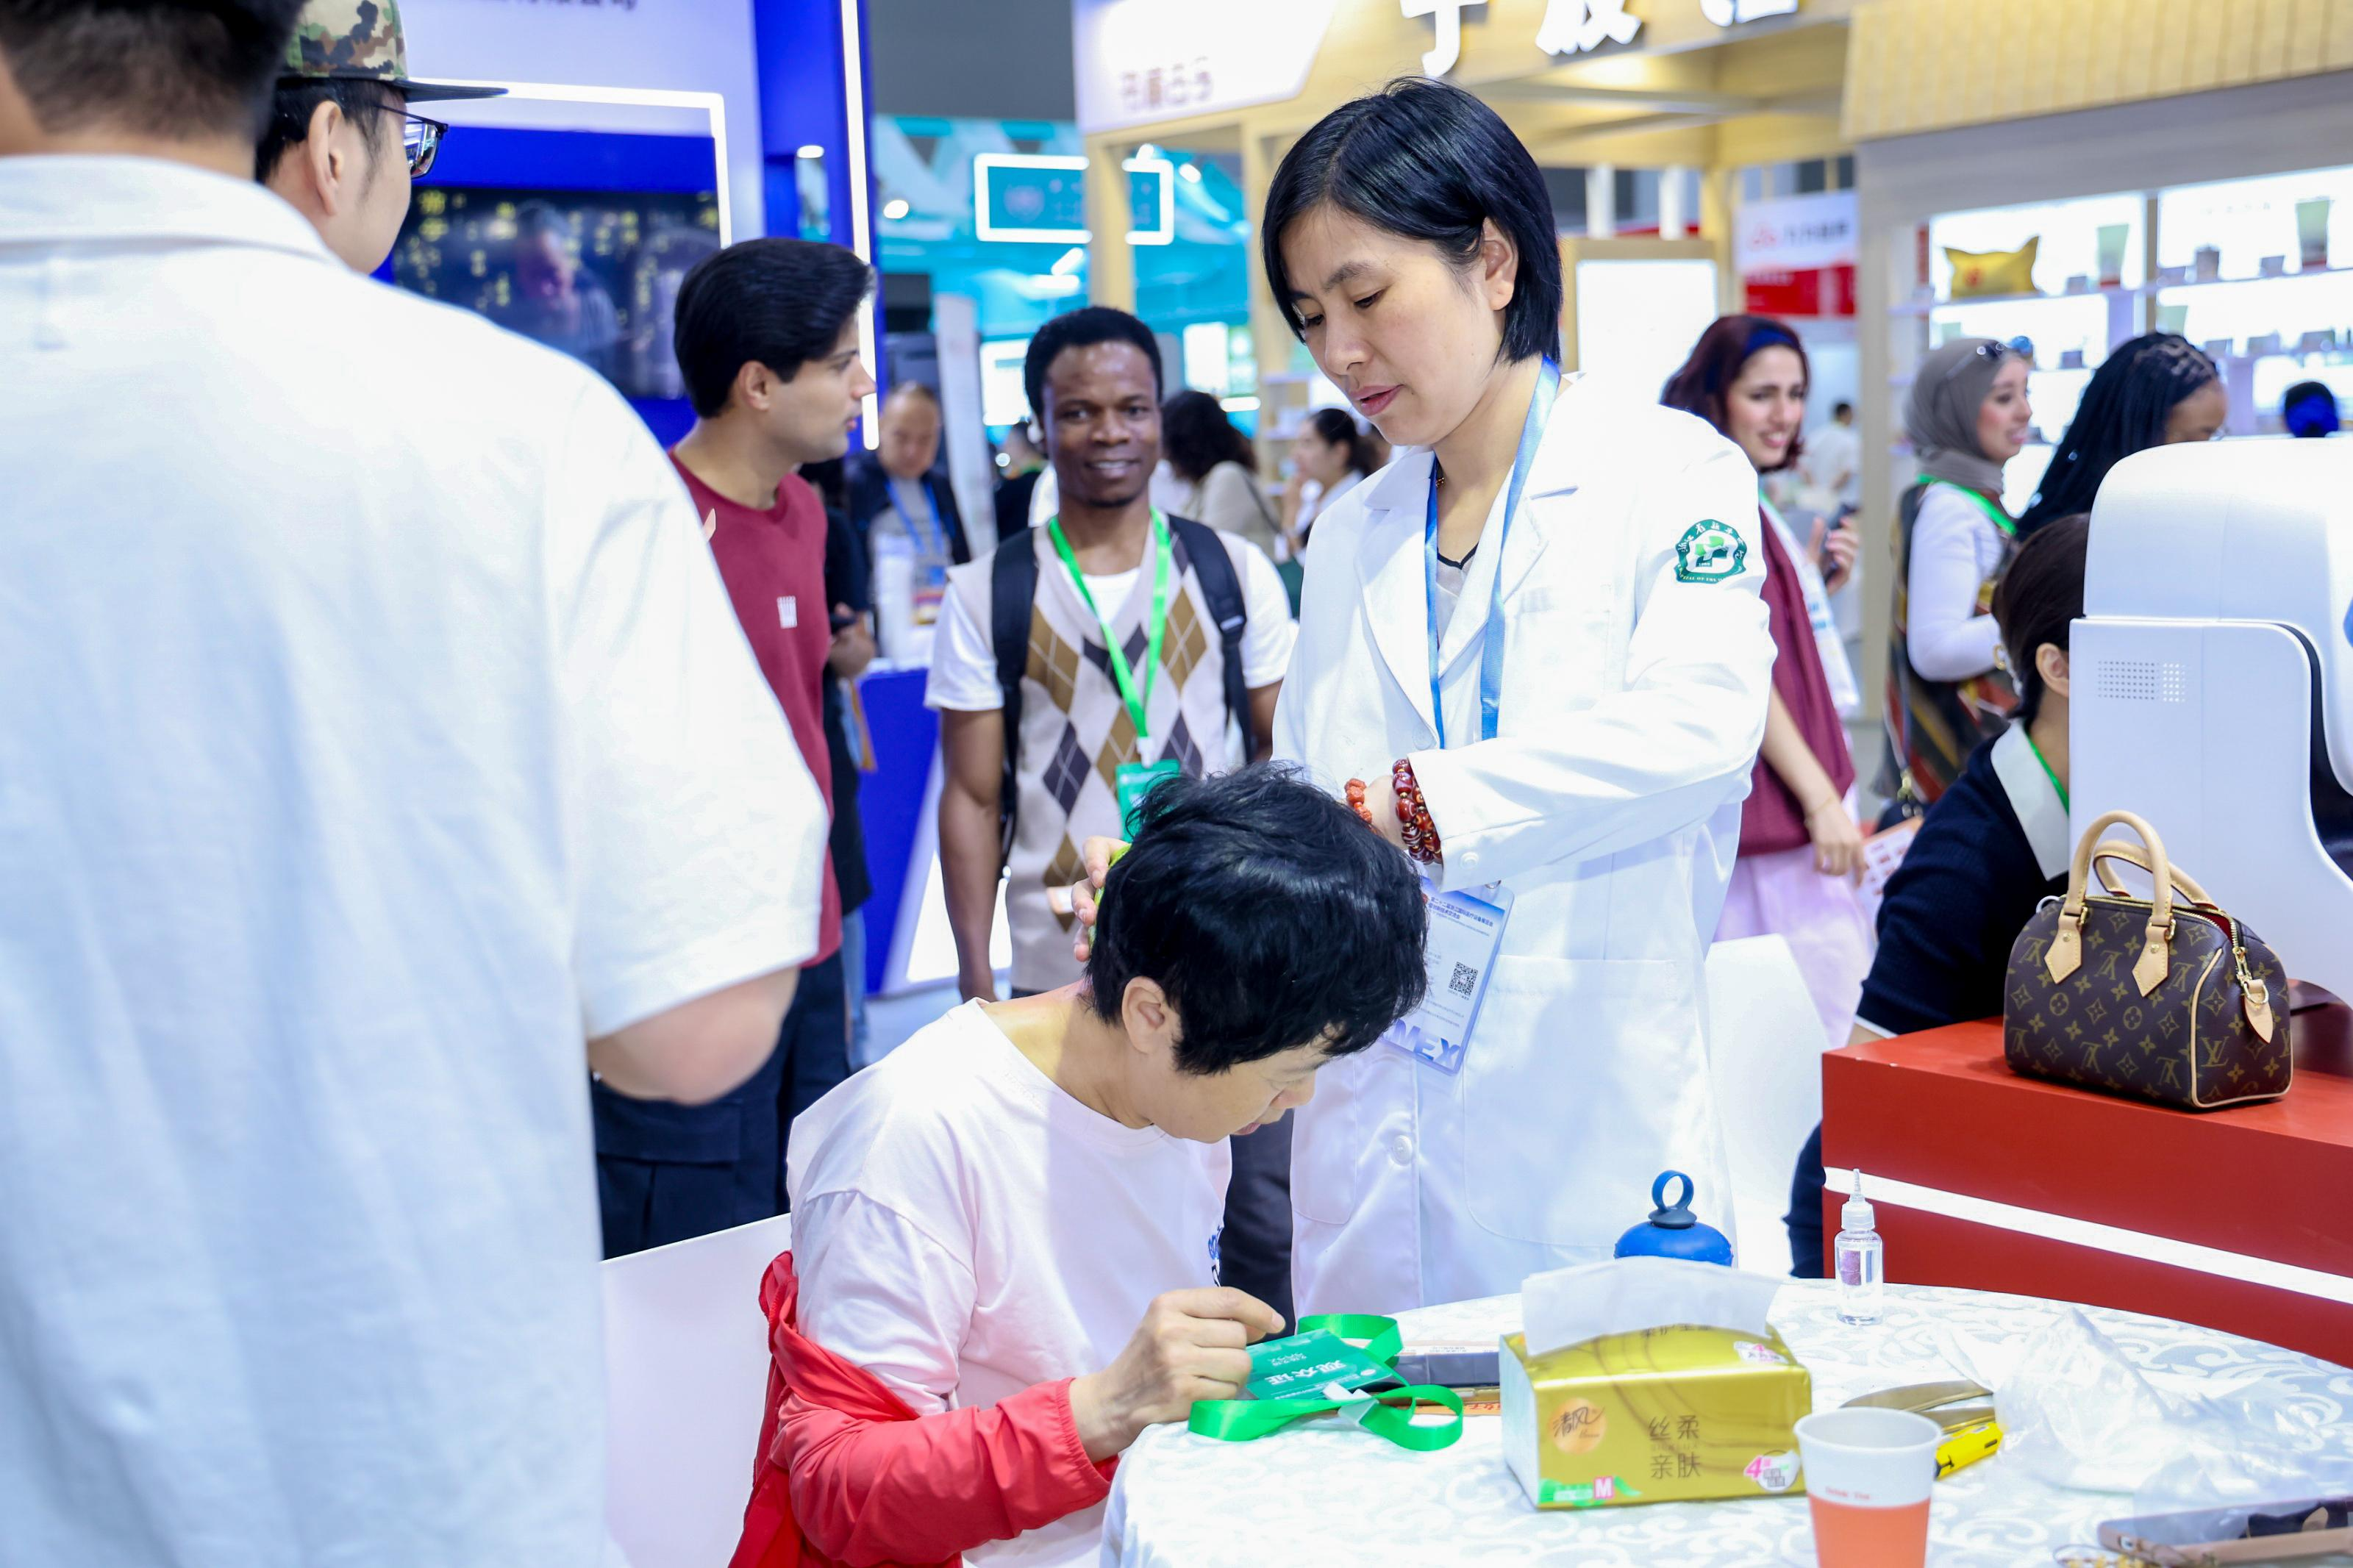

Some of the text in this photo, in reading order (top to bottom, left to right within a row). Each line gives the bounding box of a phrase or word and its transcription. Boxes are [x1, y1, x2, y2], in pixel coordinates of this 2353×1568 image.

[1265, 1359, 1347, 1386] 观众证
[1649, 1414, 1699, 1441] 丝柔
[1650, 1451, 1702, 1480] 亲肤
[1595, 1478, 1613, 1499] M
